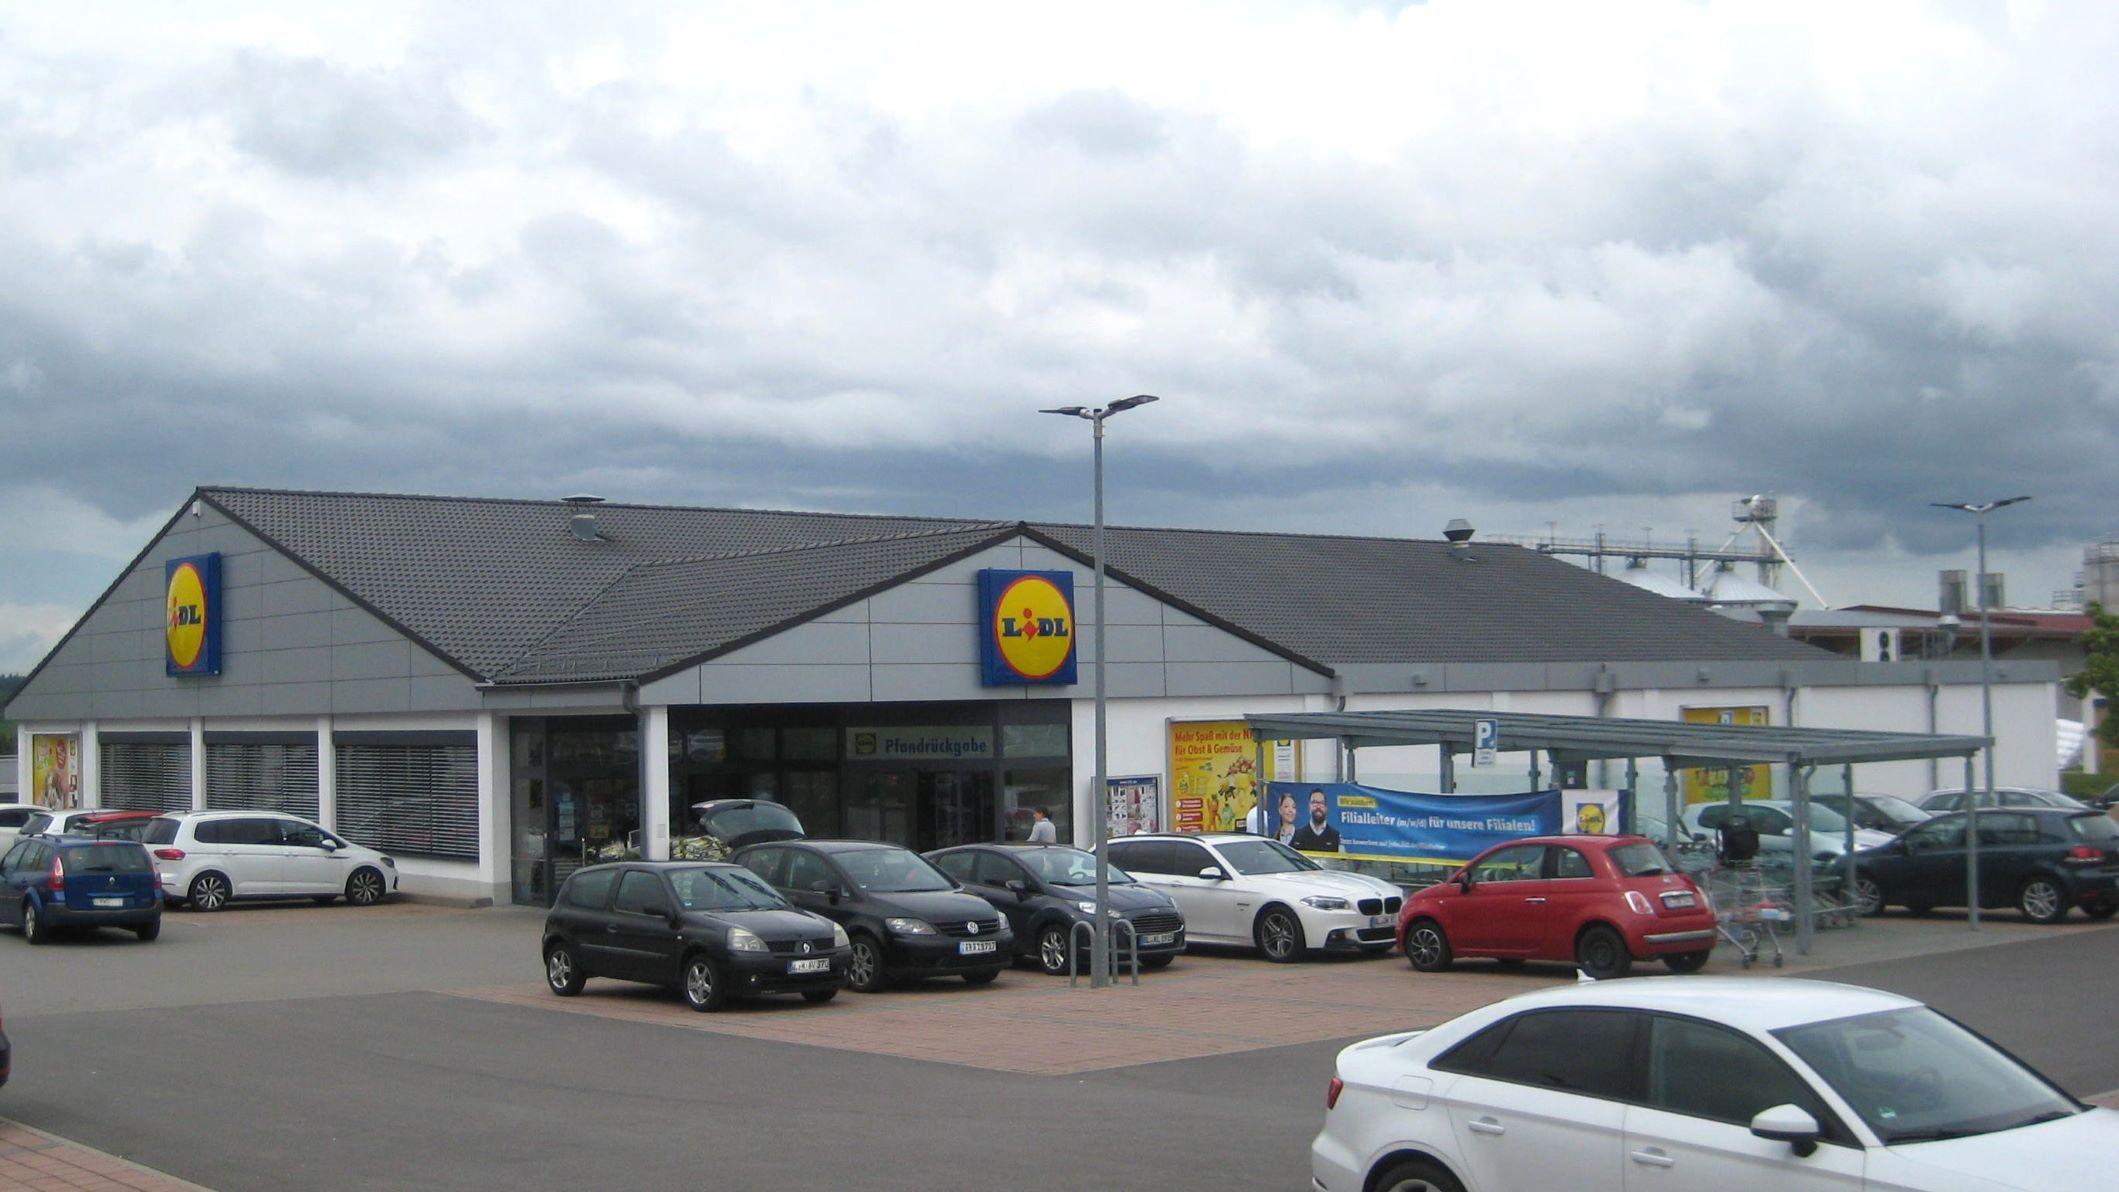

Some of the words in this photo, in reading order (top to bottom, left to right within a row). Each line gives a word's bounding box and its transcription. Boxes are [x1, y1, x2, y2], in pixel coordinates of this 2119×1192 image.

[1175, 731, 1194, 742] Mehr
[1196, 730, 1214, 743] Spaß
[1215, 730, 1228, 741] mit
[1229, 730, 1241, 740] der
[1476, 721, 1492, 748] P
[885, 735, 987, 757] Pfandrückgabe
[1175, 745, 1186, 755] für
[1187, 744, 1205, 755] Obst
[1213, 743, 1242, 754] Gemüse
[1341, 811, 1396, 826] Filialleiter
[1428, 816, 1444, 829] für
[1446, 818, 1485, 831] unsere
[1486, 818, 1536, 832] Filialen!
